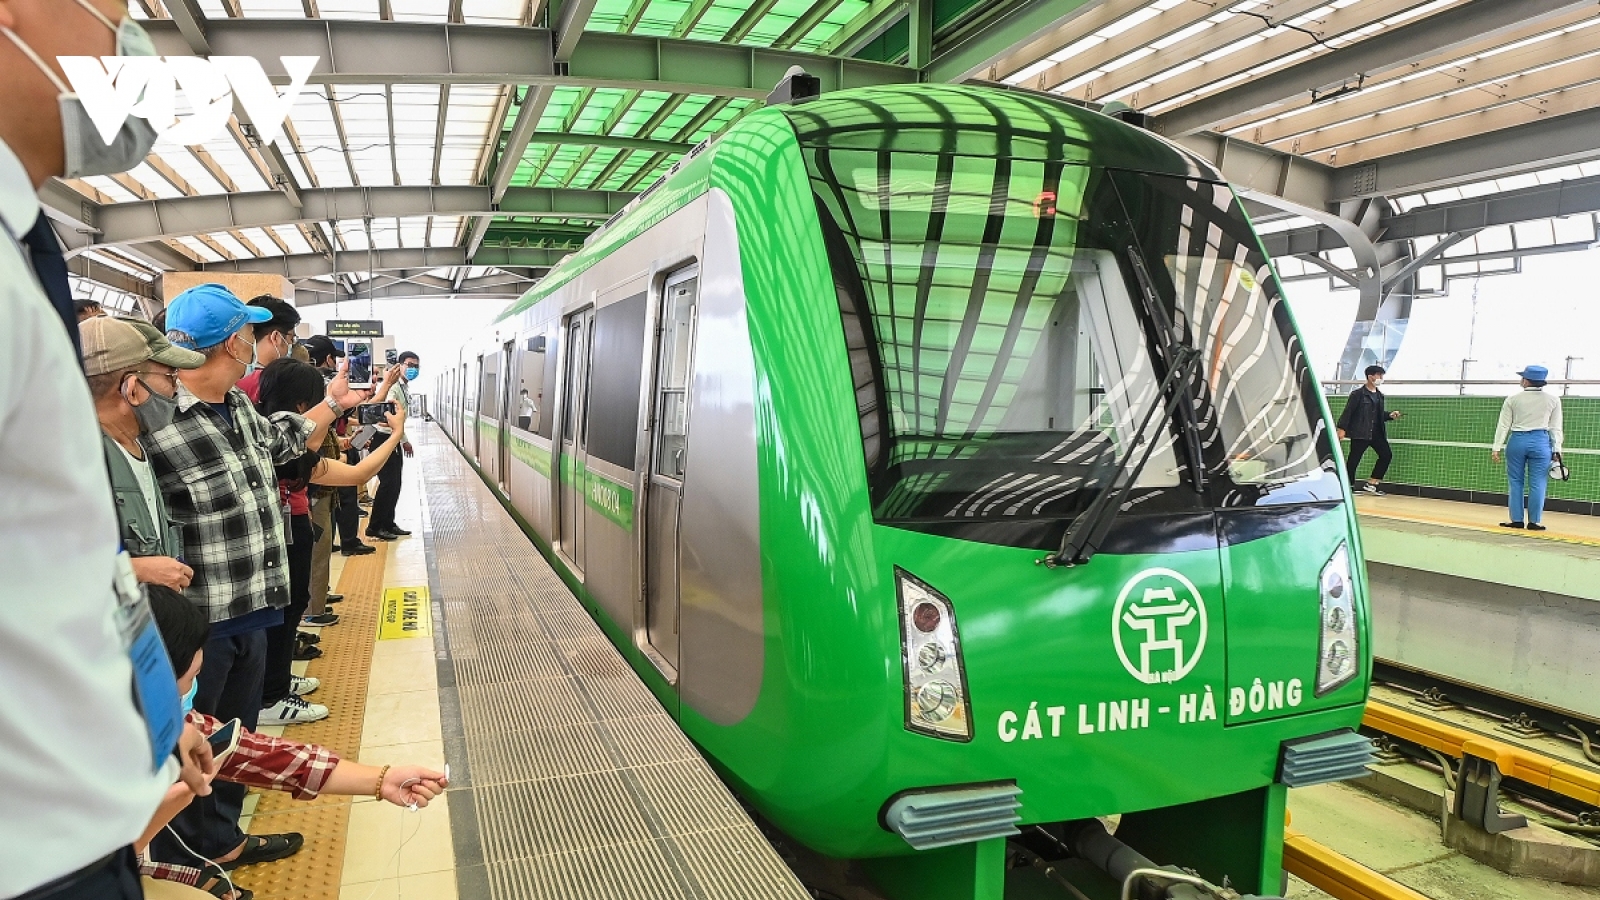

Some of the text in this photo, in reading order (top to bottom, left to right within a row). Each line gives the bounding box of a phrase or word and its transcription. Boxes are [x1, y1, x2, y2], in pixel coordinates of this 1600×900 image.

[997, 677, 1303, 742] CÁT LINH - HÀ ĐÔNG
